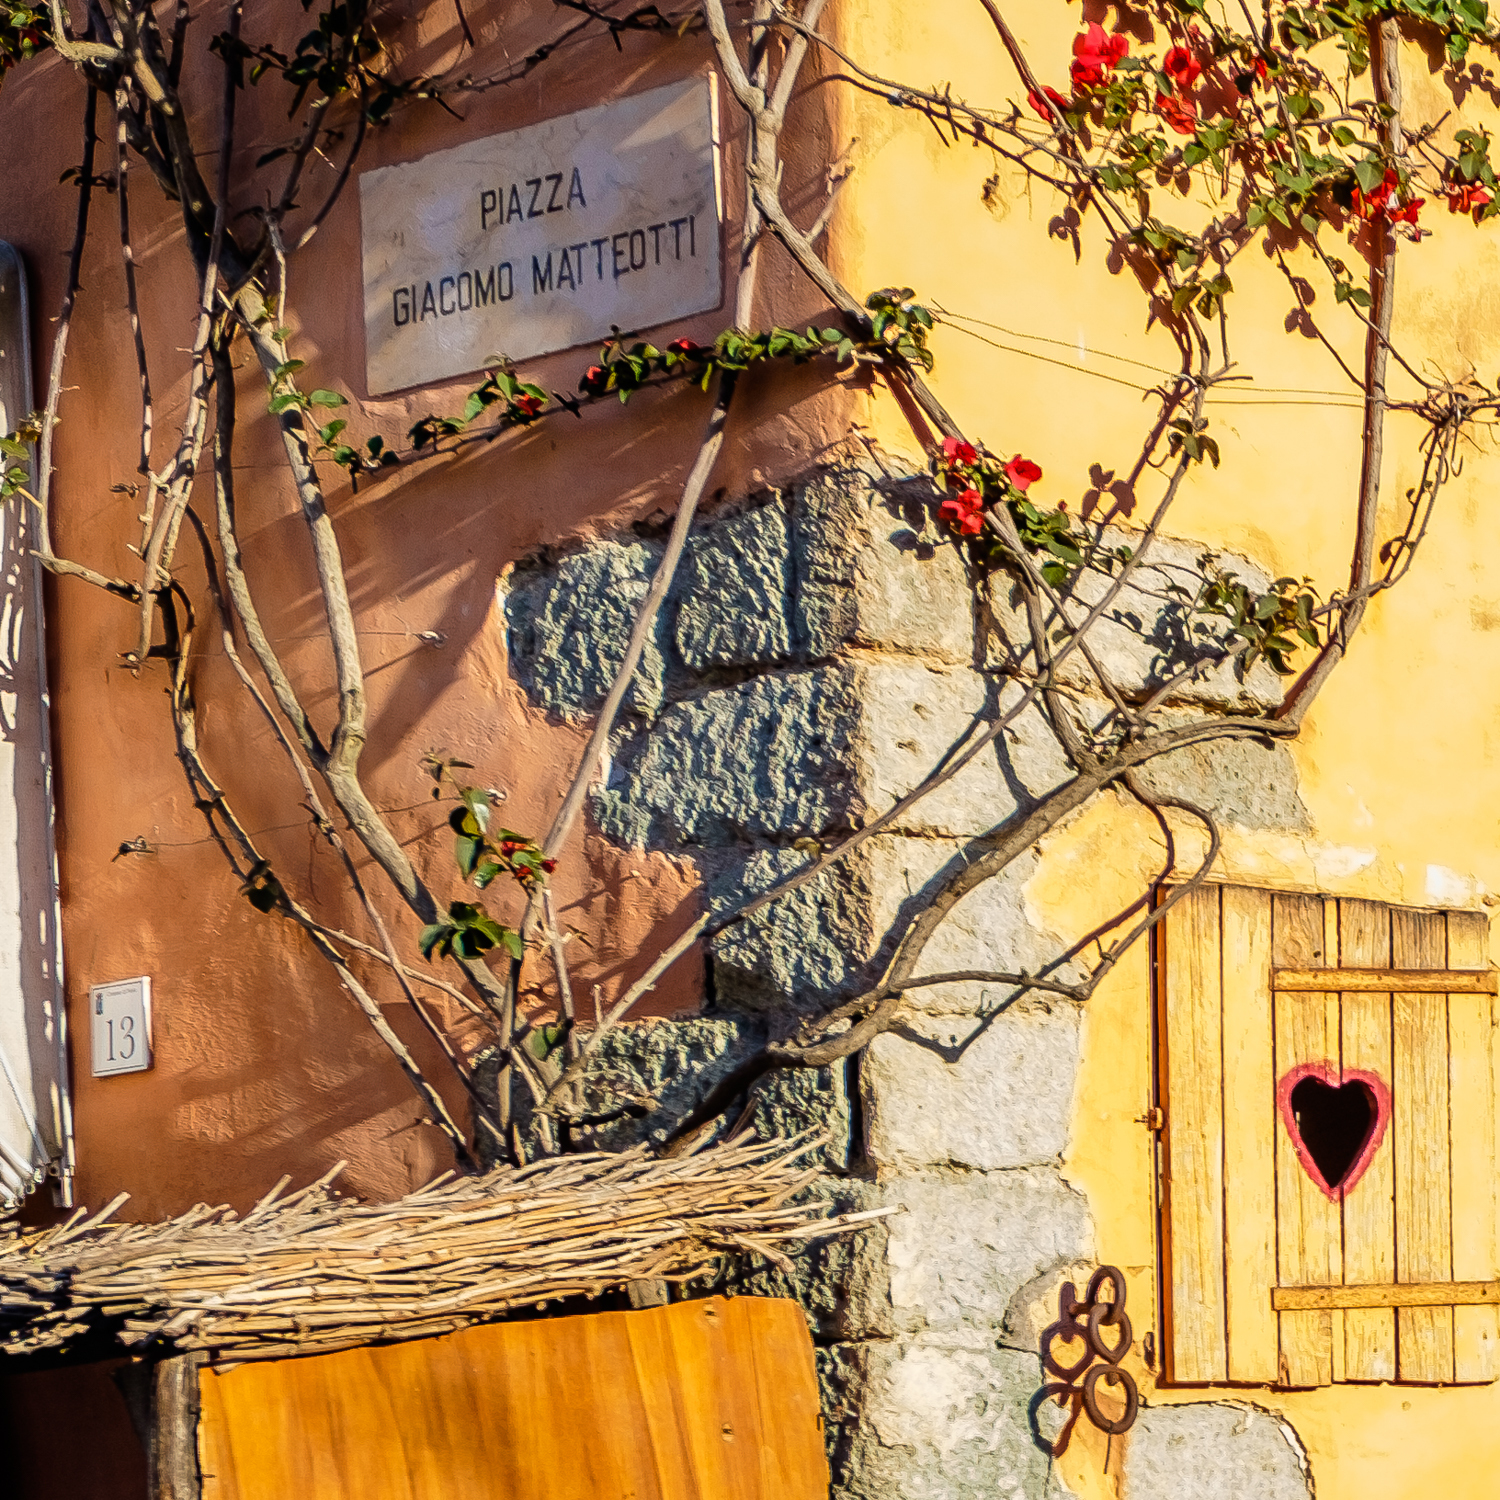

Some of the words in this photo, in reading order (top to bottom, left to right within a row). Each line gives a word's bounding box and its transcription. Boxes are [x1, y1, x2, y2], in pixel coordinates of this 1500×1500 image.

[480, 166, 587, 231] PIAZZA
[392, 260, 514, 328] GIACOMO
[532, 214, 697, 297] MATTEOTTI
[105, 1015, 136, 1062] 13
